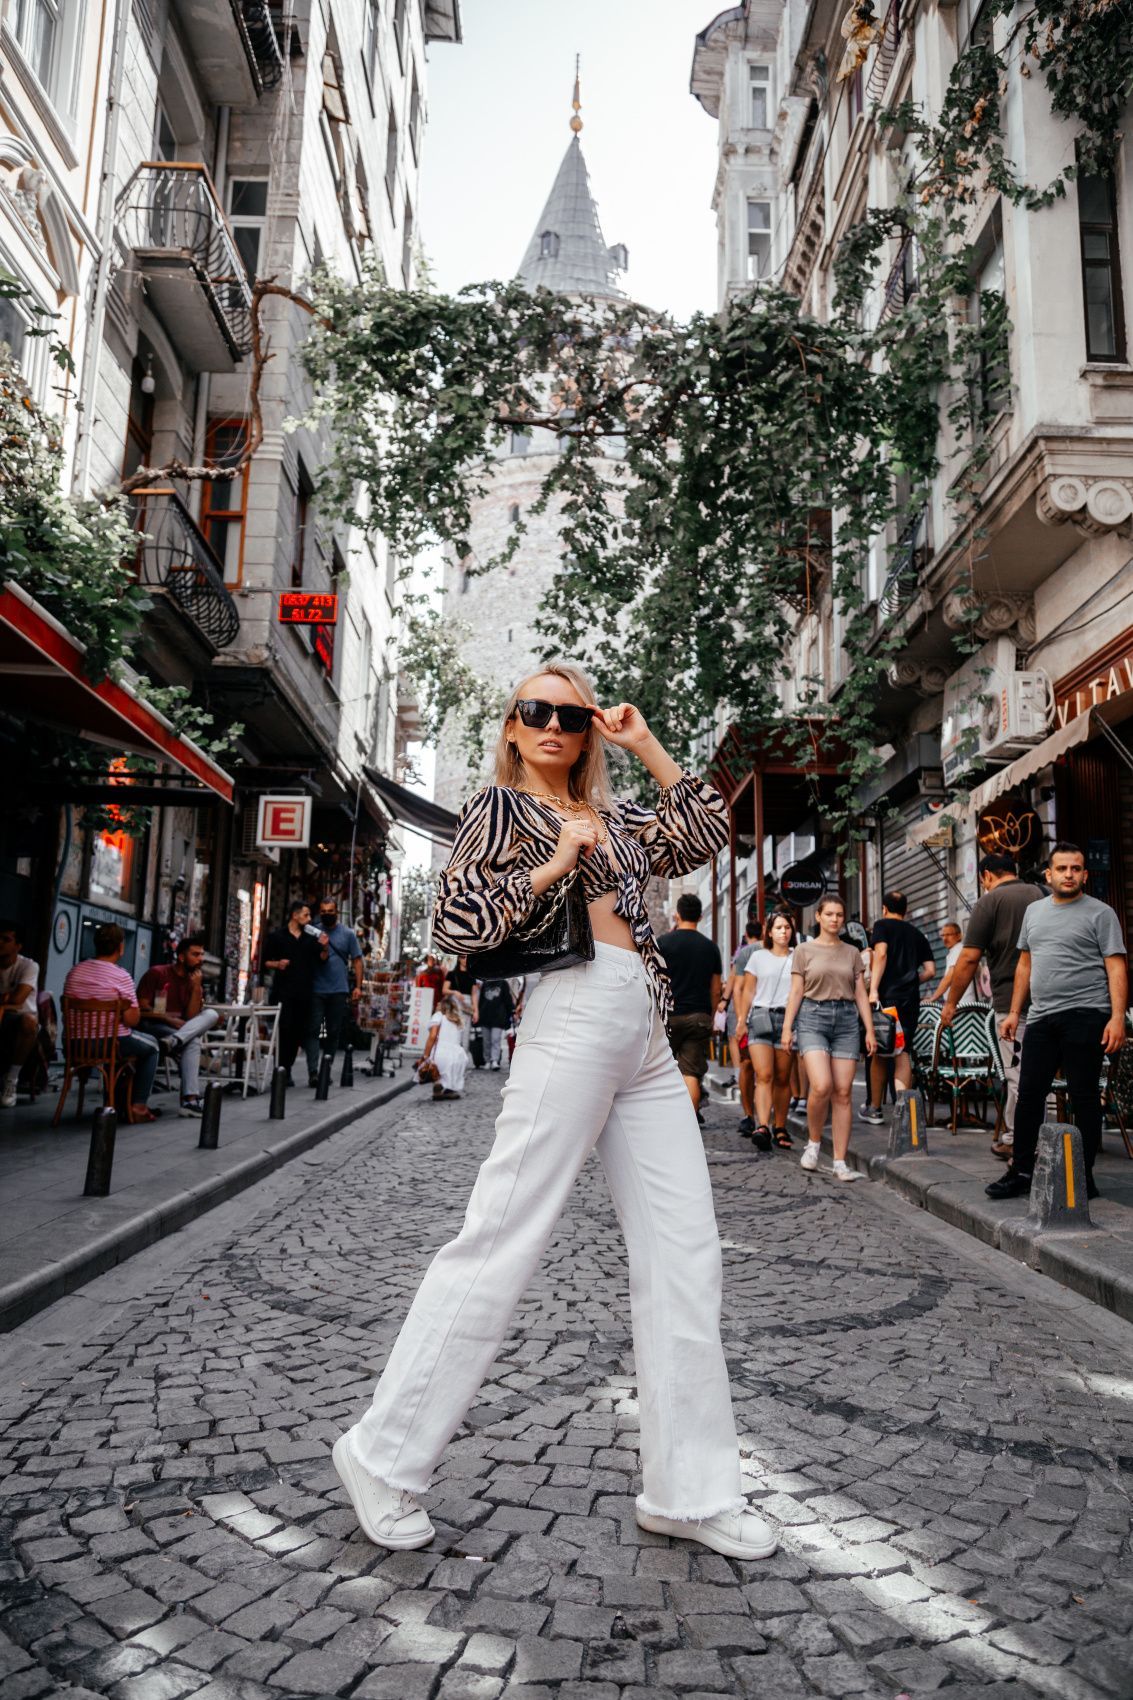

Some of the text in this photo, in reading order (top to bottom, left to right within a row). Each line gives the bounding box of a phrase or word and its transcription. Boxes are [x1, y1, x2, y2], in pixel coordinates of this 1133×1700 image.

[312, 596, 332, 608] 413
[308, 609, 322, 621] 72
[271, 807, 296, 836] E
[411, 989, 422, 1045] ECZANE
